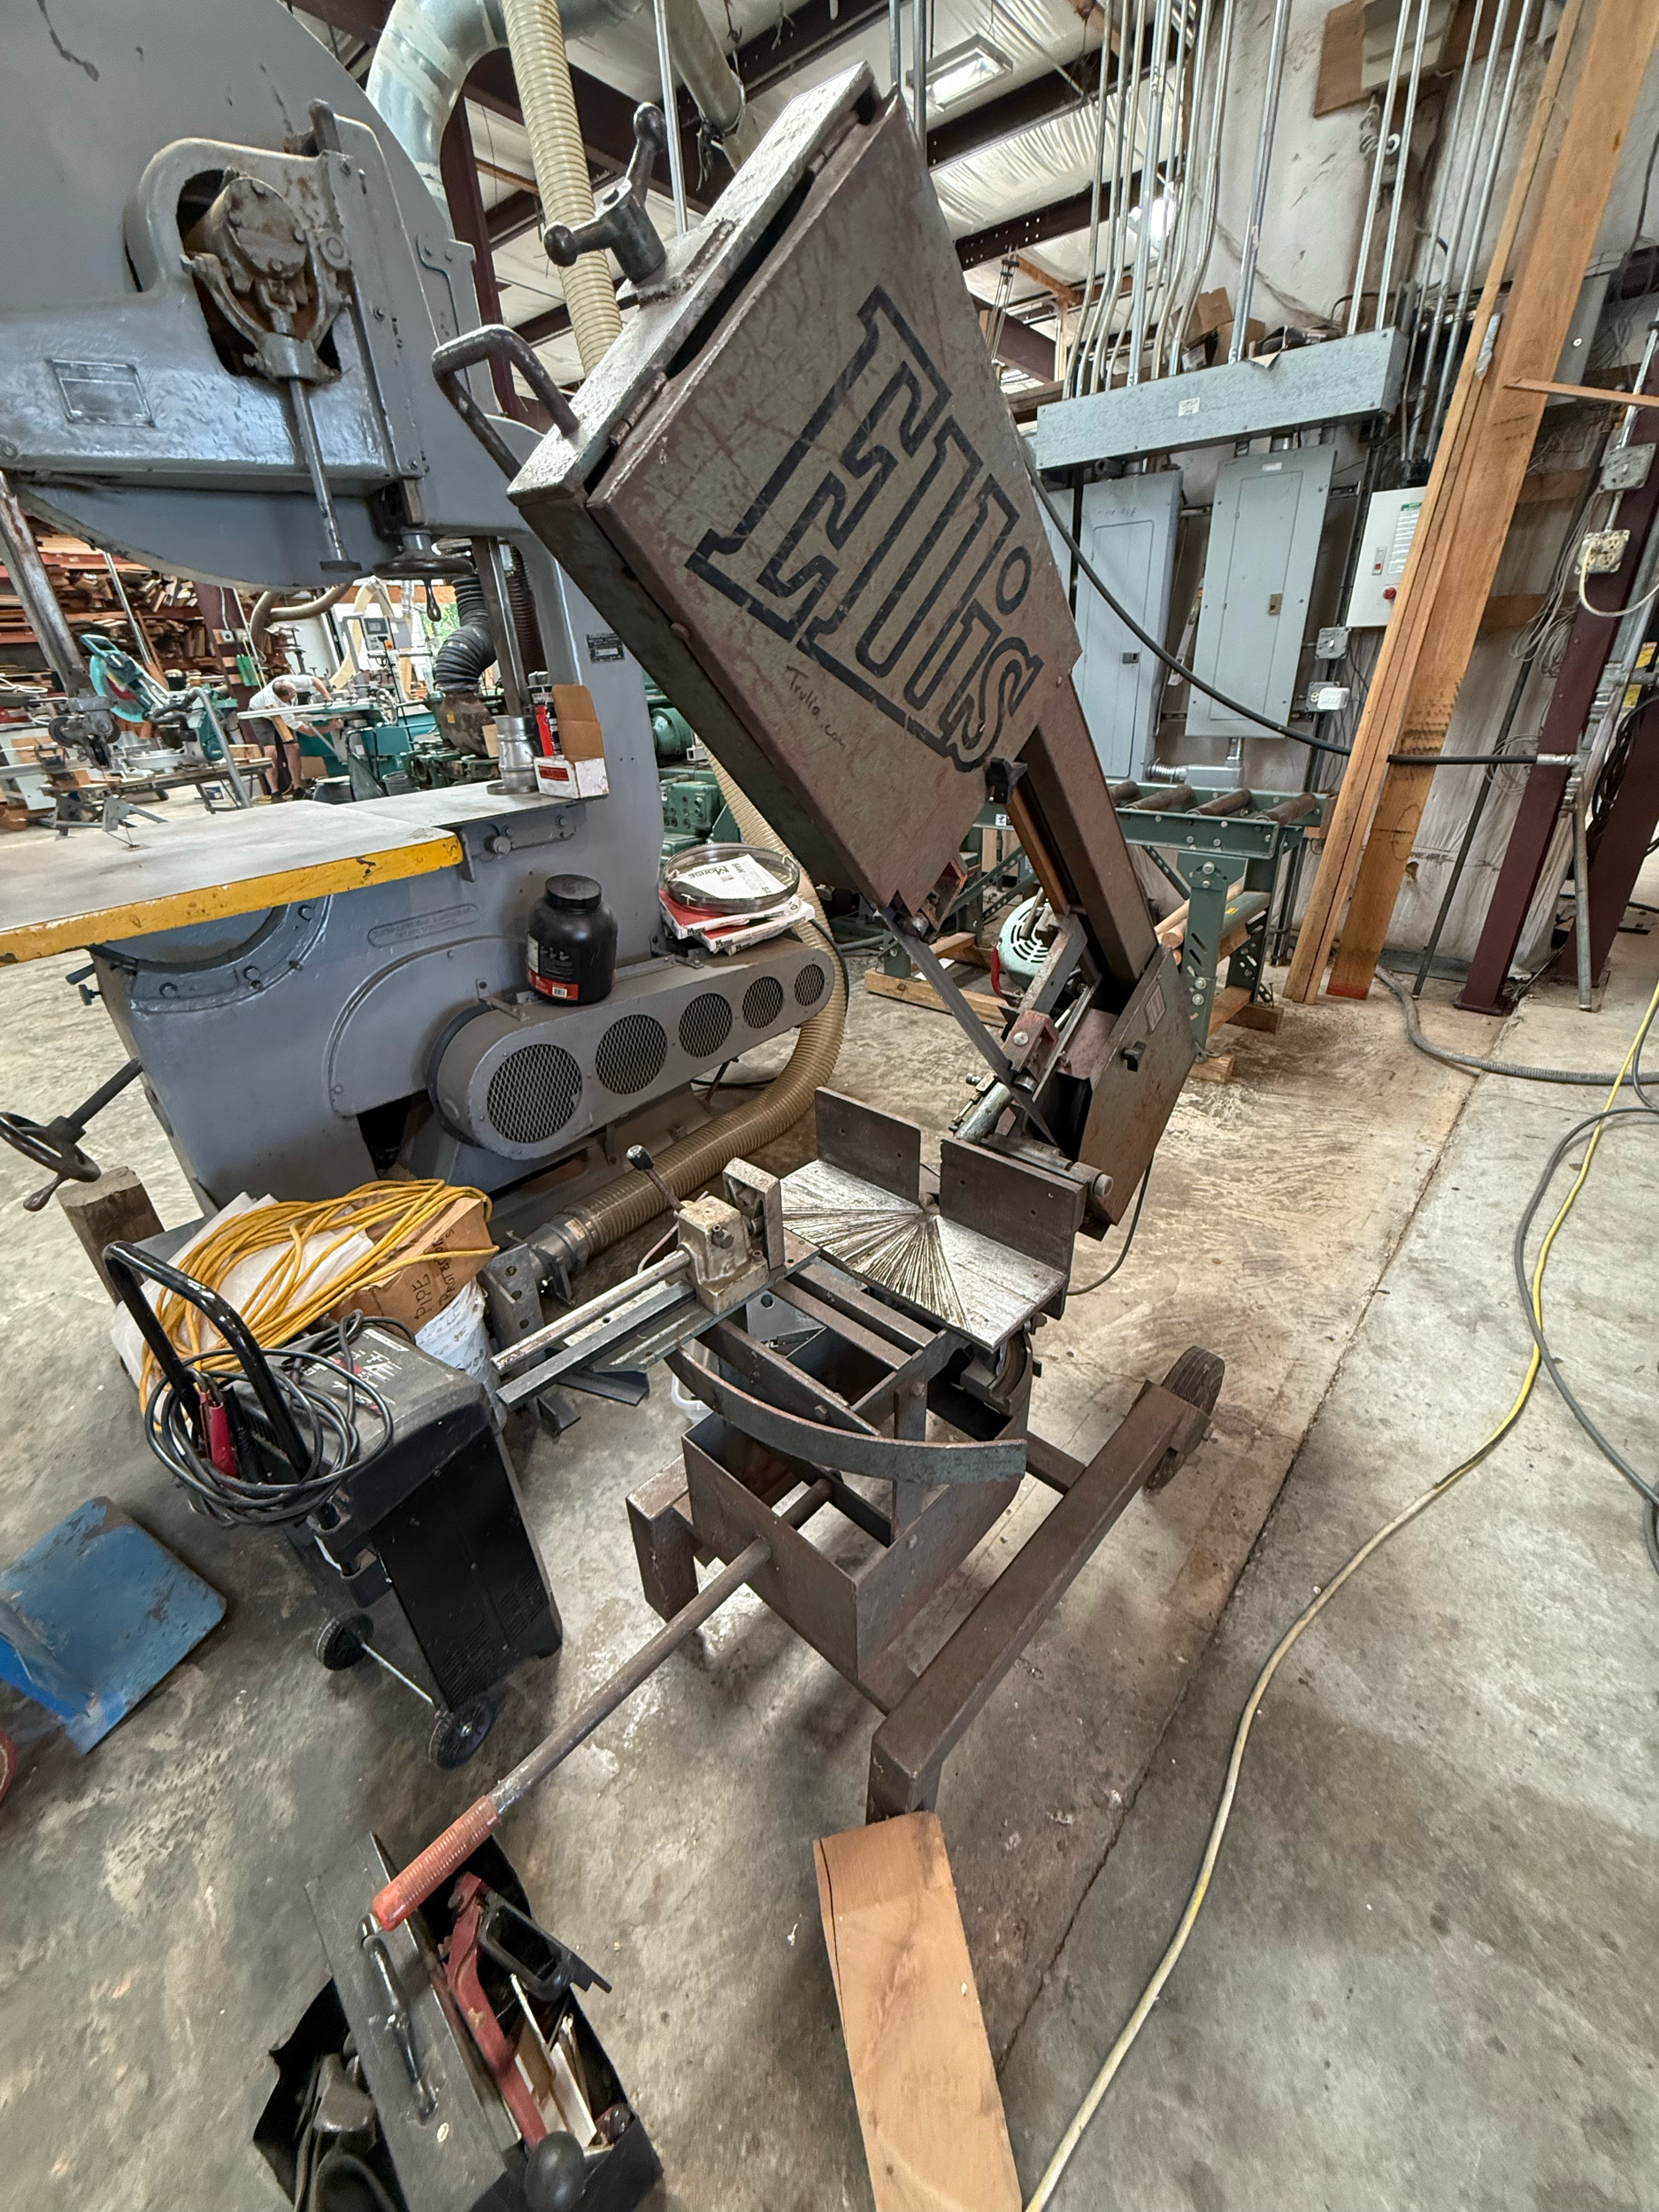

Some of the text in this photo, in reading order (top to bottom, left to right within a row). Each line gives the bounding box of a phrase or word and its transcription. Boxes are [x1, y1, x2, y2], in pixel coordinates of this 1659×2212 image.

[684, 286, 1044, 772] Ellis
[411, 1273, 431, 1320] PIPE
[432, 1228, 456, 1307] PROTECORS
